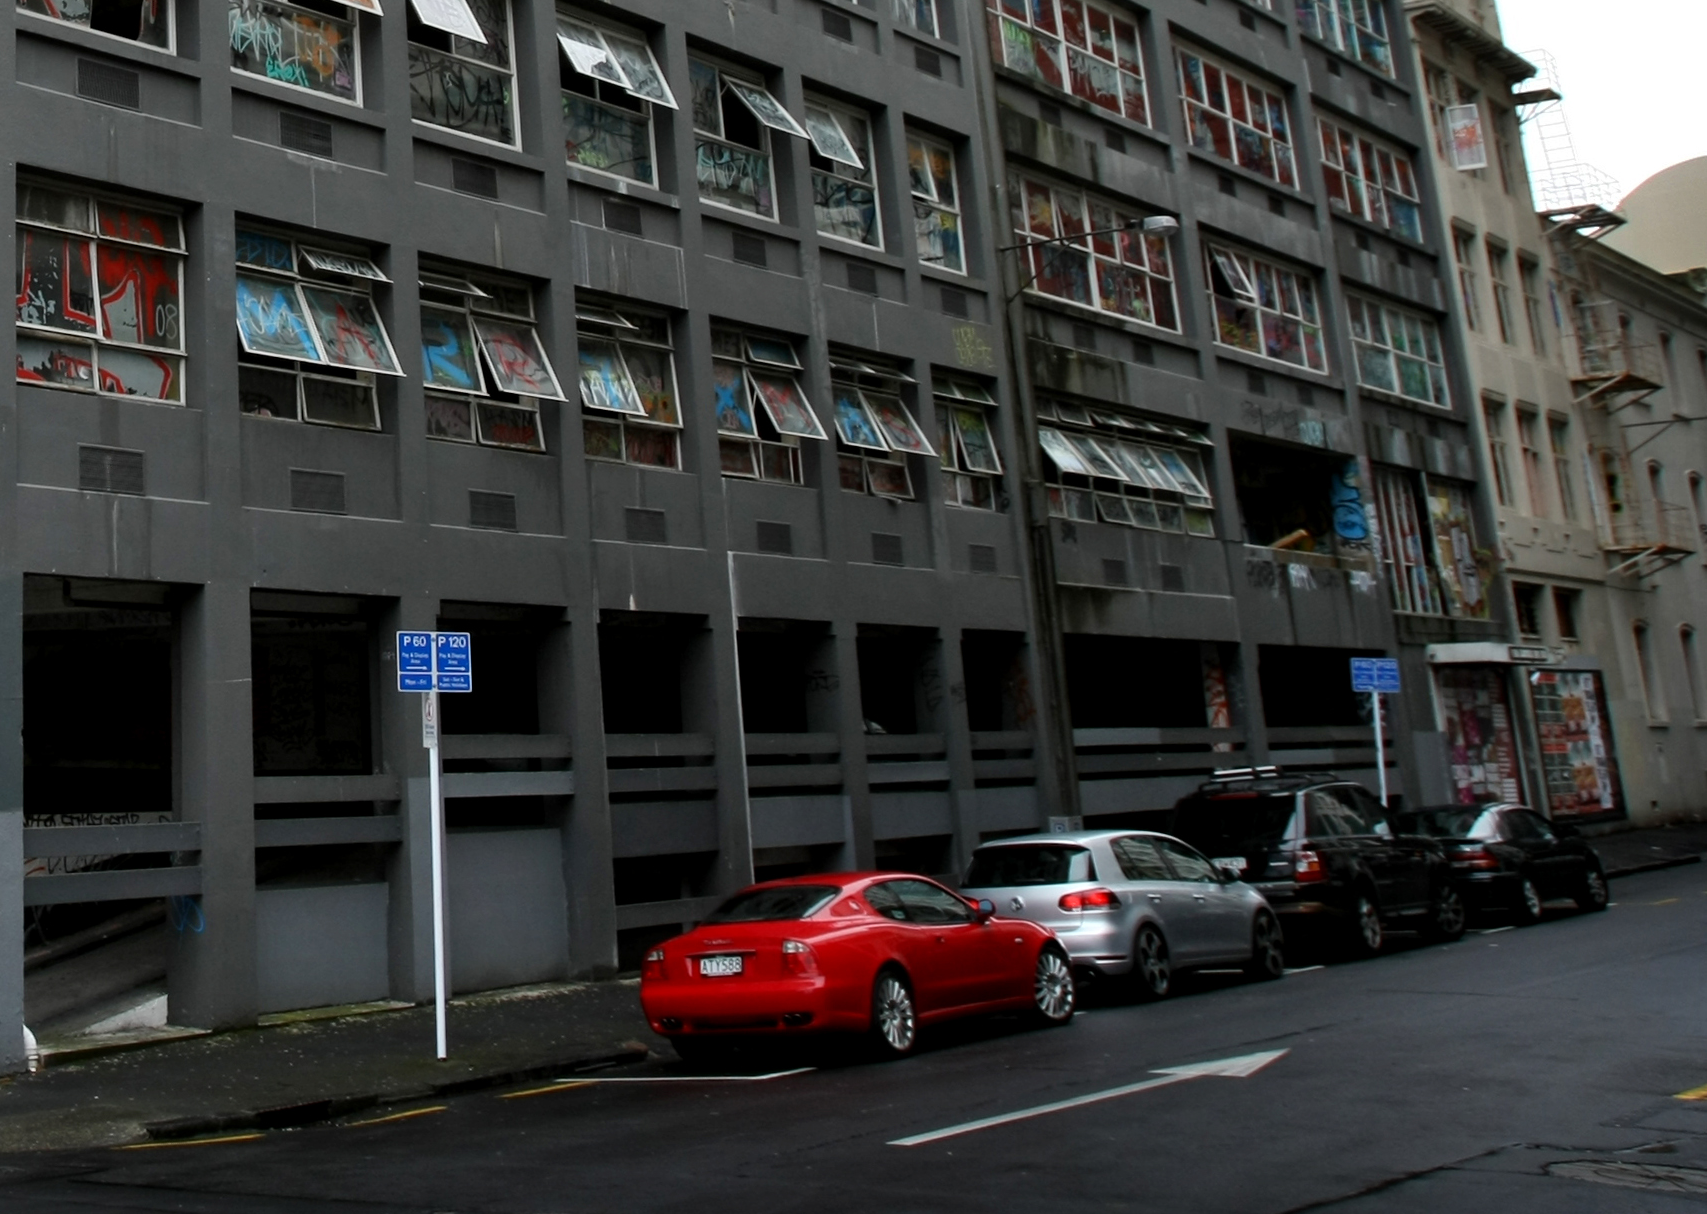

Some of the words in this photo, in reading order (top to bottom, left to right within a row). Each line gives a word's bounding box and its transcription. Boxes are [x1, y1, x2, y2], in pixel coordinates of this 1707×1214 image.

[403, 636, 411, 647] P
[413, 636, 427, 647] 60
[438, 636, 446, 647] P
[448, 636, 467, 648] 120
[702, 958, 742, 973] ATY588
